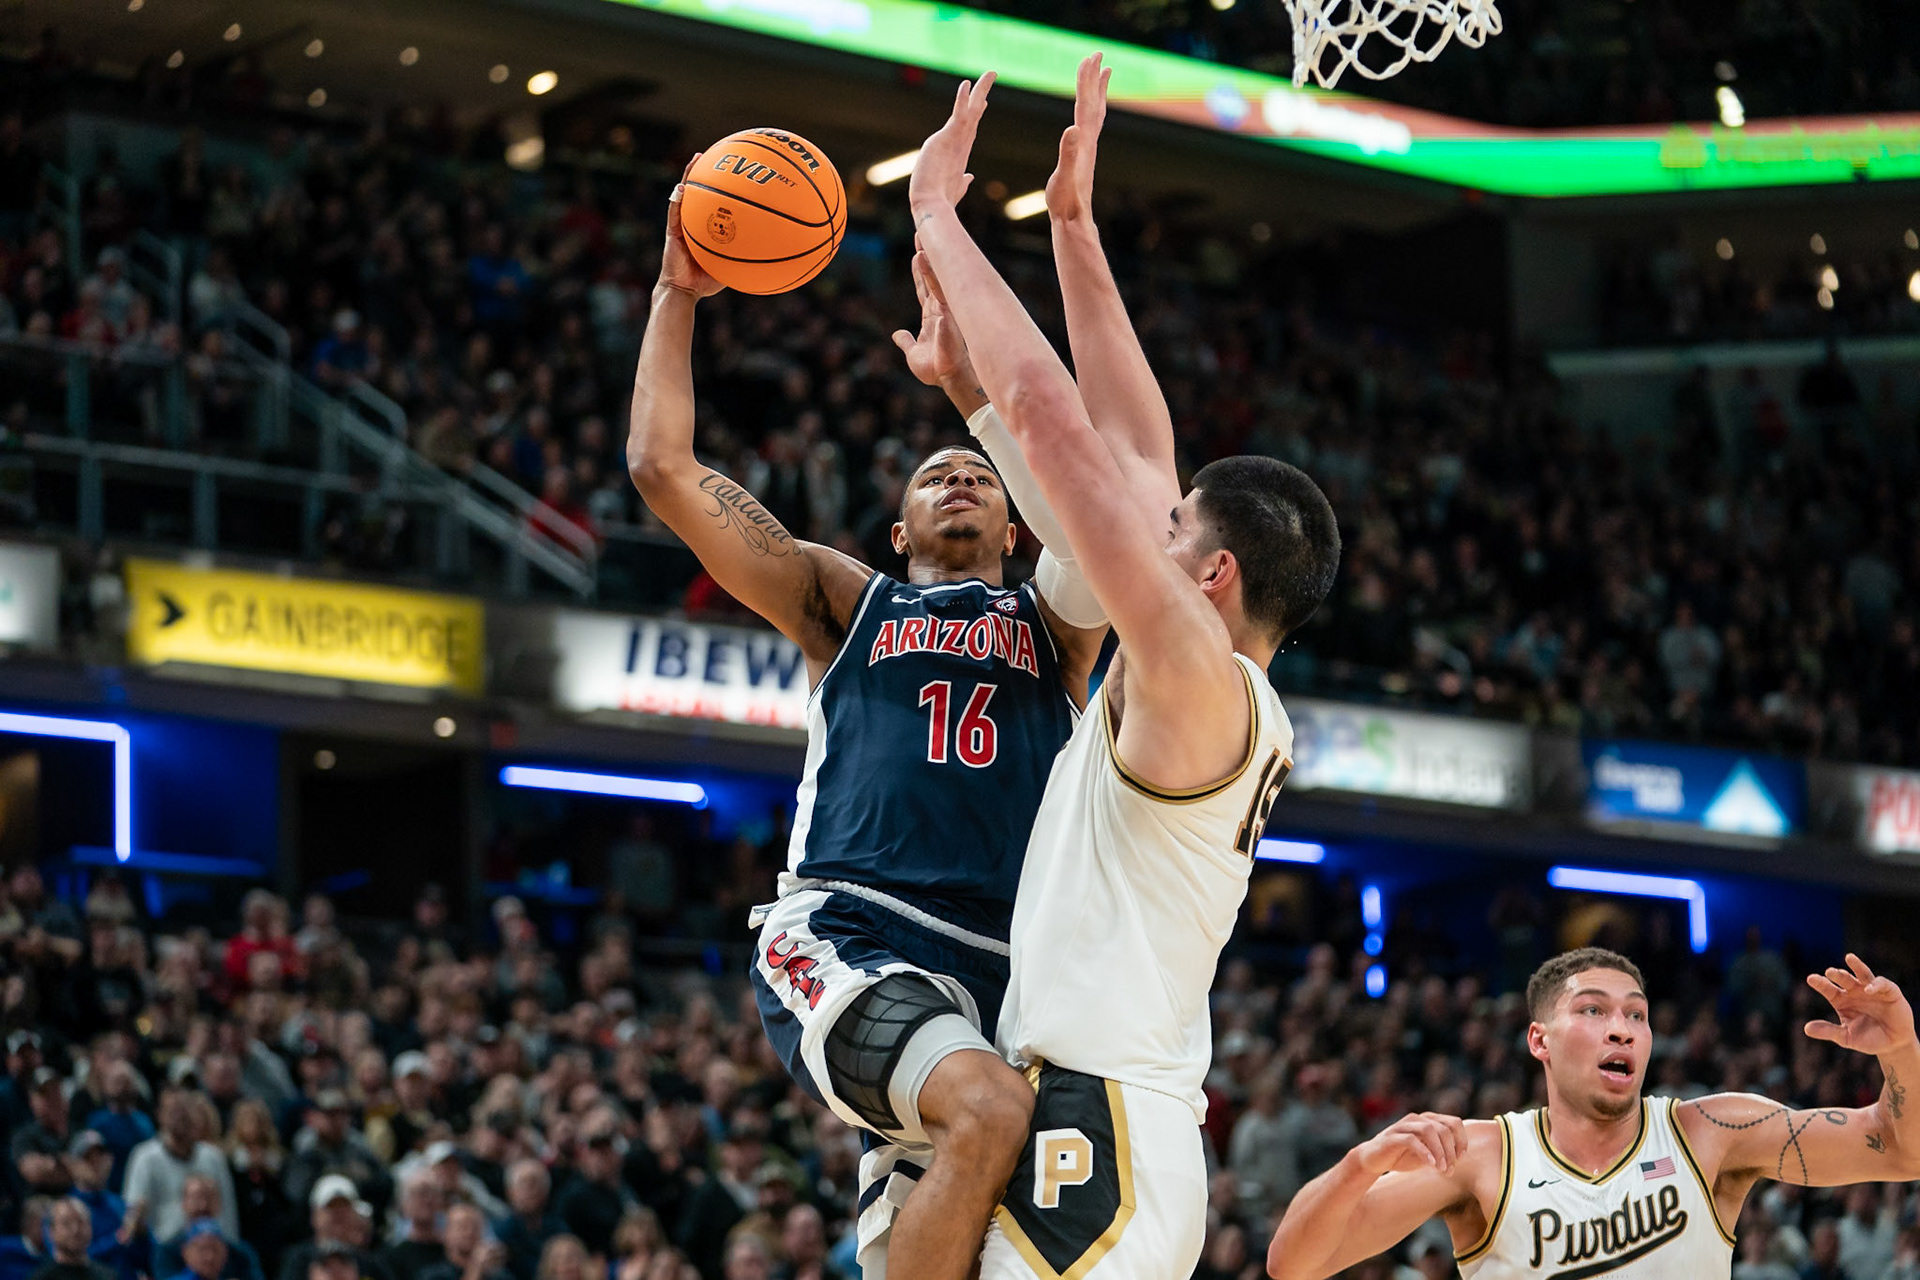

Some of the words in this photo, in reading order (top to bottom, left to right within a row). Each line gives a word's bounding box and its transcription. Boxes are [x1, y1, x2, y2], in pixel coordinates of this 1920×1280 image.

[713, 154, 777, 185] EVO
[776, 174, 798, 188] NXT
[207, 592, 464, 667] GAINBRIDGE
[624, 628, 804, 690] IBEW
[868, 612, 1040, 679] ARIZONA
[918, 680, 998, 768] 16
[1868, 774, 1920, 838] PO
[1033, 1128, 1093, 1208] P
[1527, 1184, 1688, 1269] Purdue
